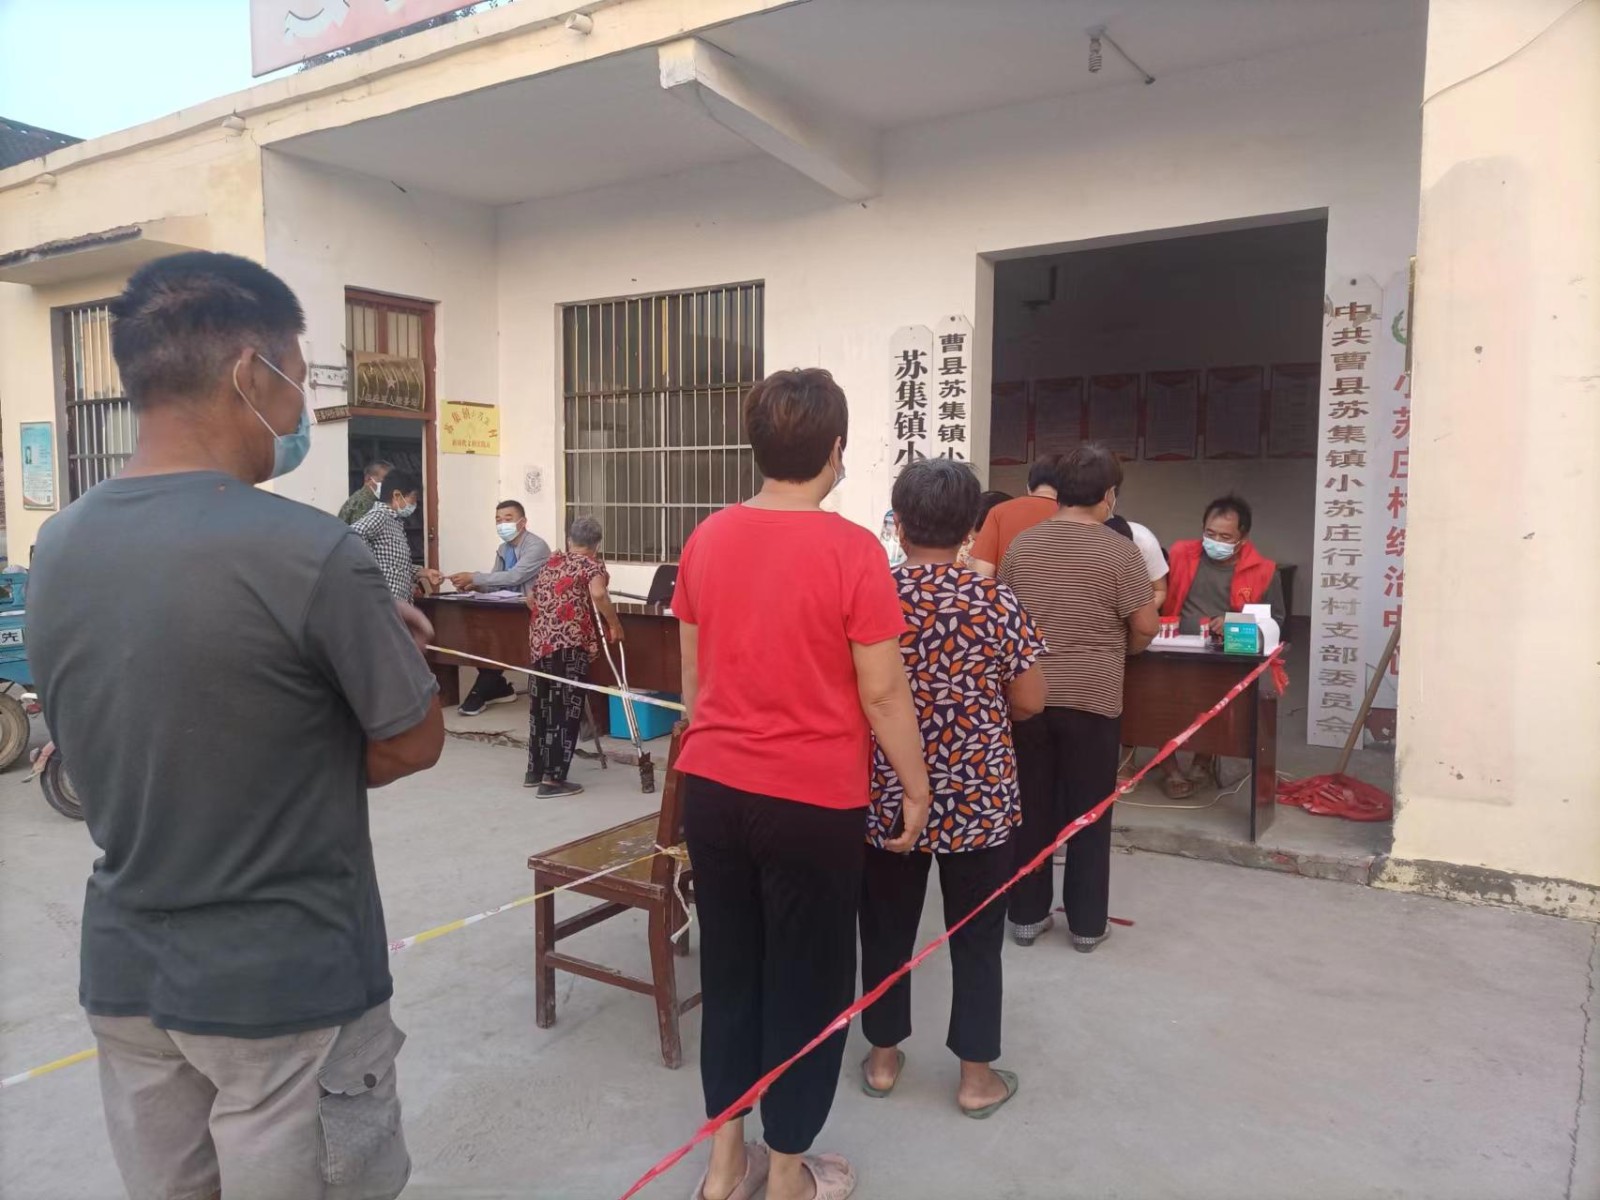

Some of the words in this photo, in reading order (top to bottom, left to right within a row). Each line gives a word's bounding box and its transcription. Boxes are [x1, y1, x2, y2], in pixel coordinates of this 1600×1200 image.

[893, 349, 928, 479] 苏集镇小
[937, 333, 967, 463] 曹县苏集镇小
[1316, 301, 1372, 735] 中共曹县苏集镇小苏庄行政村支部委员会
